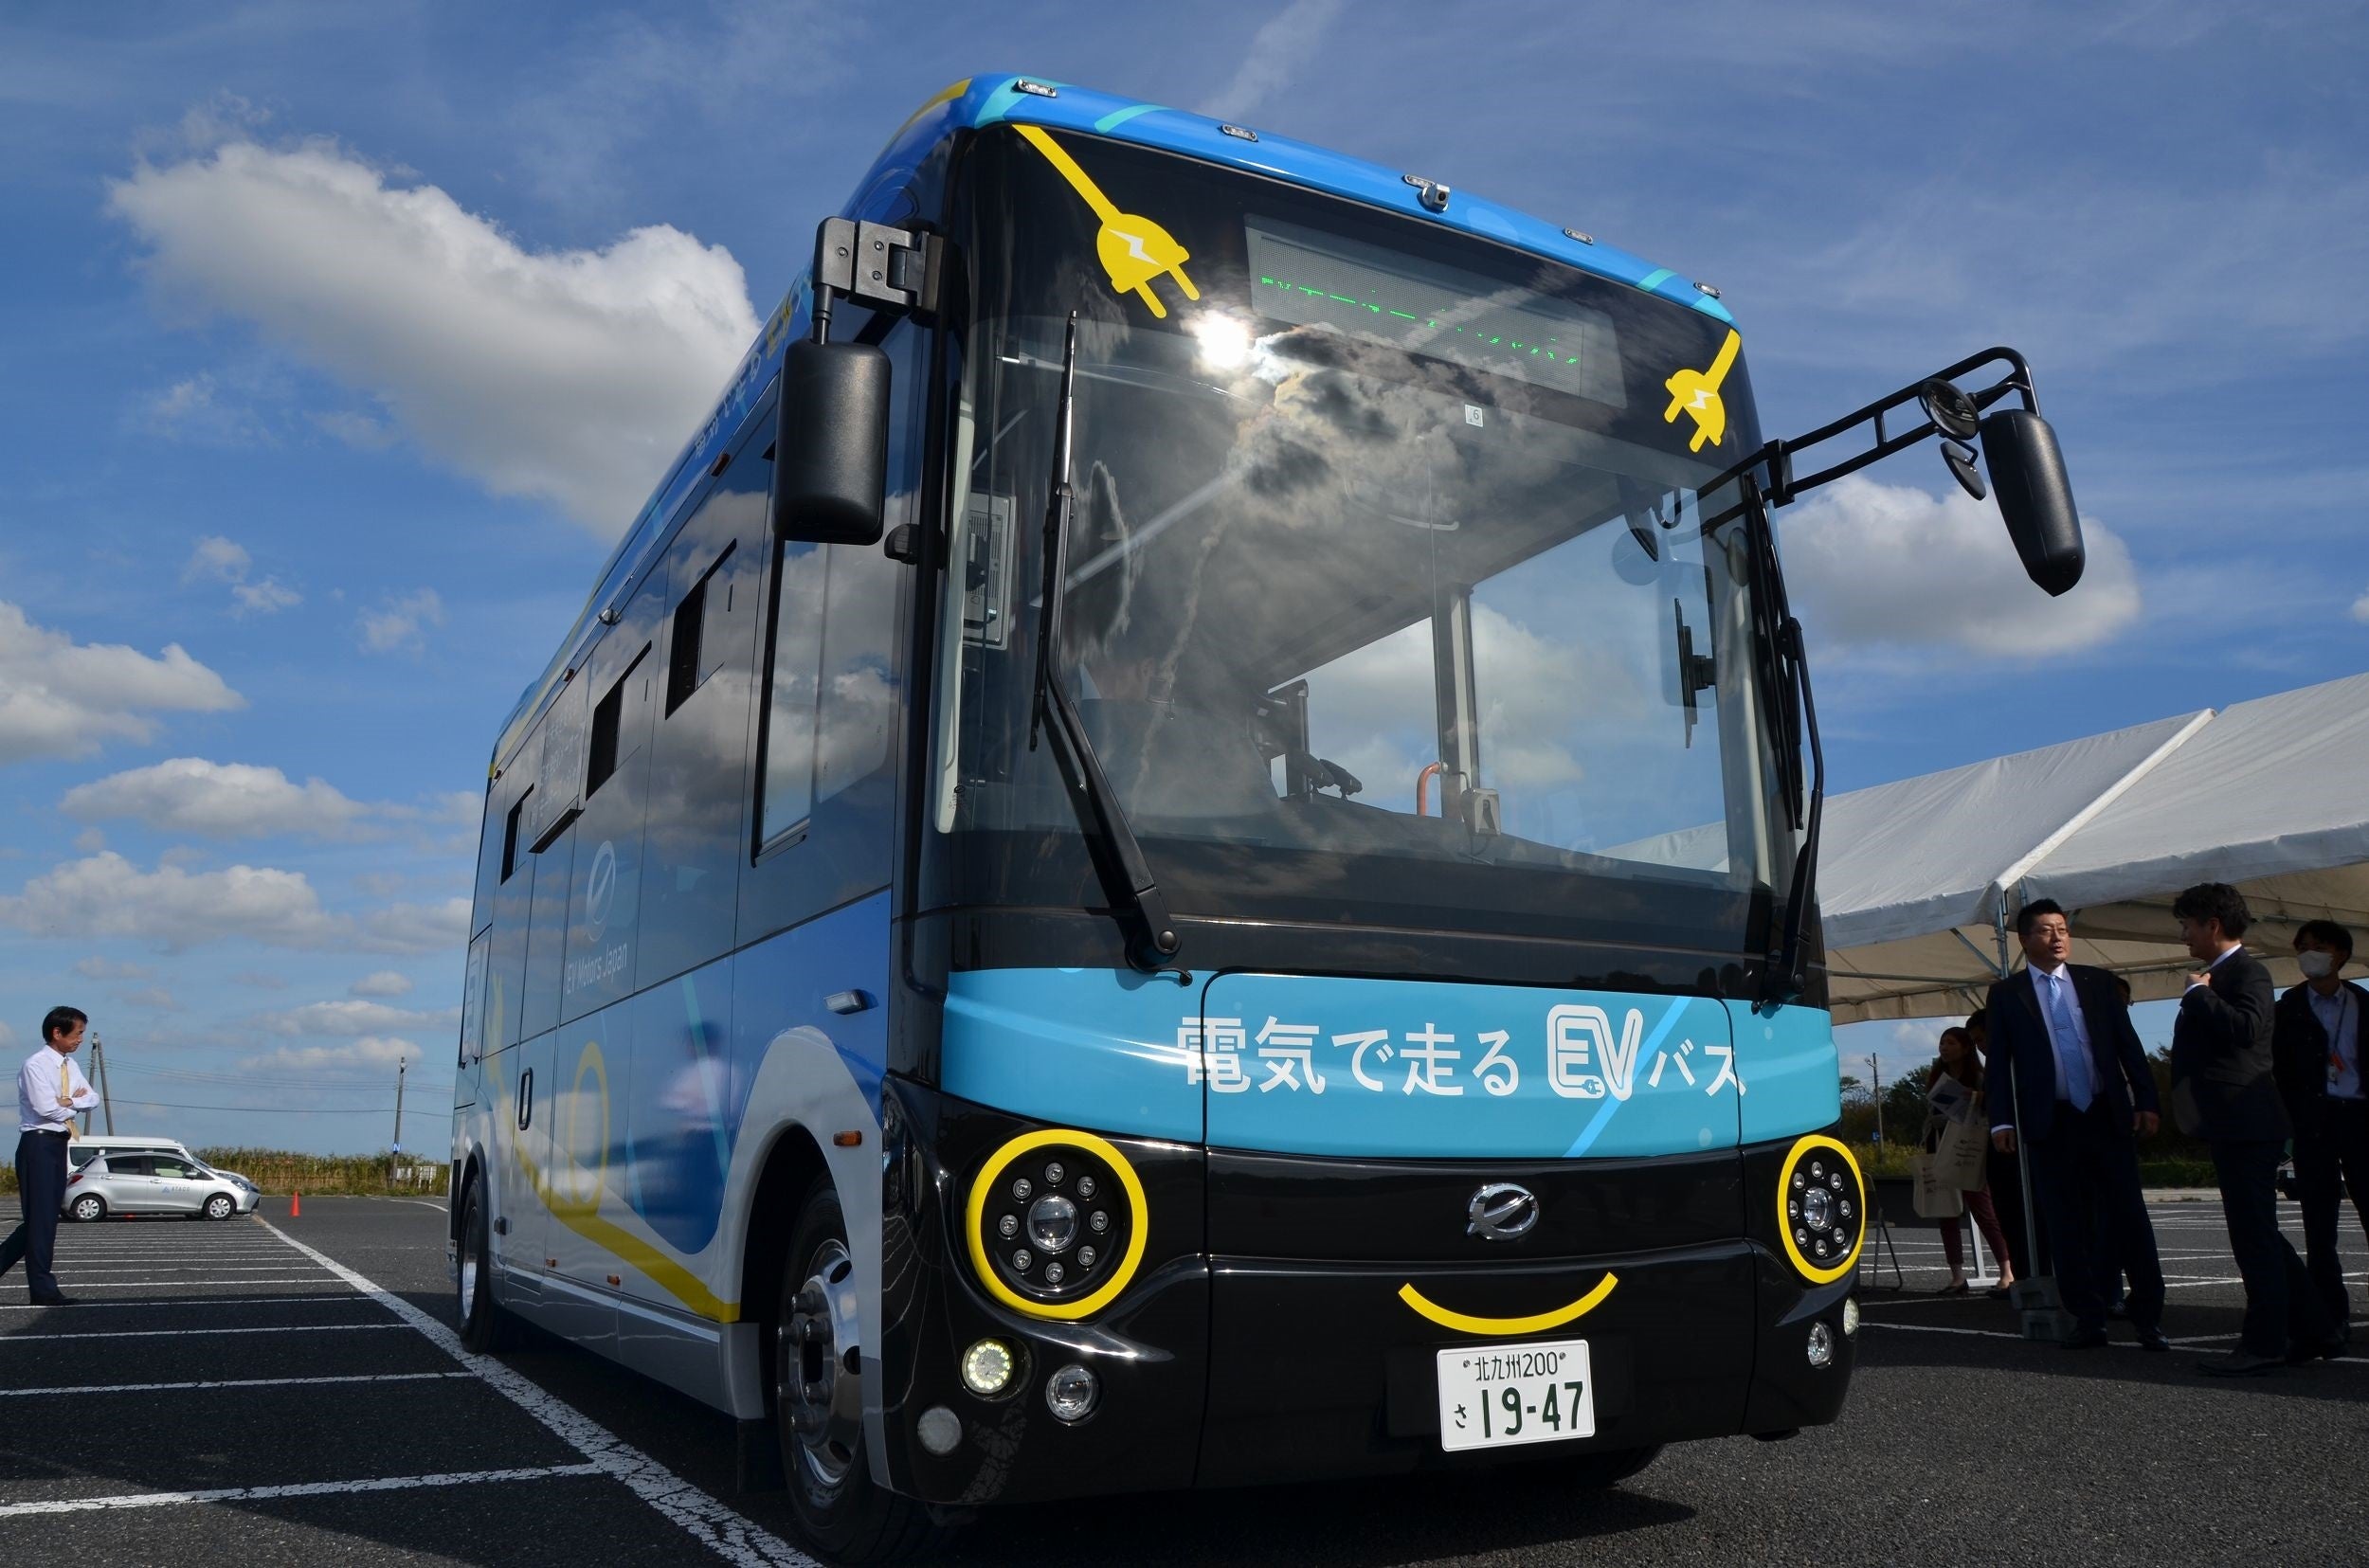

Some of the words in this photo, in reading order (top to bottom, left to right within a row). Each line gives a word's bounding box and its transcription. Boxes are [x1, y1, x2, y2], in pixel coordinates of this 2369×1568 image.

[567, 958, 578, 994] EV
[576, 954, 602, 989] Motors
[603, 942, 627, 984] Japan
[1474, 1351, 1558, 1382] 北九州200
[1454, 1403, 1467, 1428] さ
[1482, 1380, 1583, 1439] 19-47
